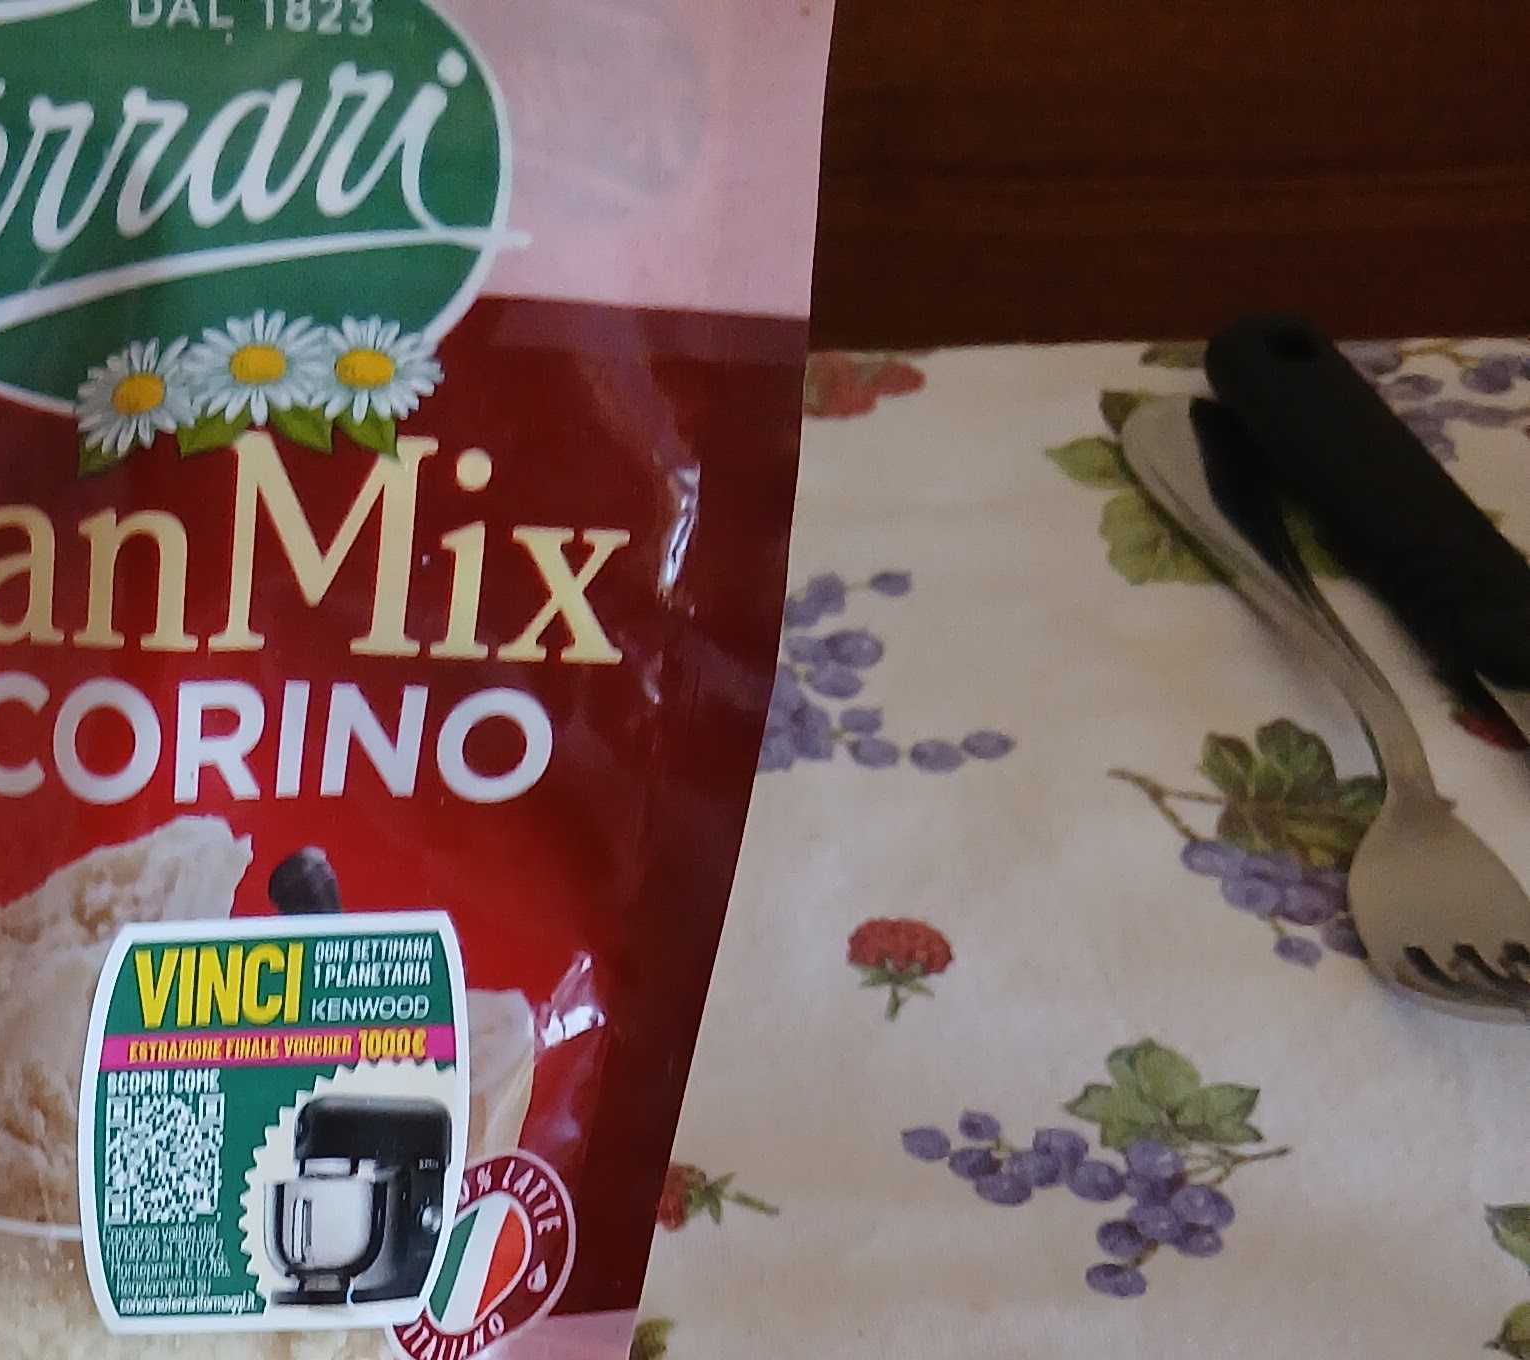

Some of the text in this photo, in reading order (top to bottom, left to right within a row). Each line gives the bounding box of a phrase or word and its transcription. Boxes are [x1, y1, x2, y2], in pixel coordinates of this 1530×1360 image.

[129, 0, 374, 36] DAL 1823
[351, 937, 433, 962] SETTIMANA
[134, 942, 304, 1030] VINCI
[324, 960, 431, 990] PLANETARIA
[311, 994, 430, 1022] KENWOOD
[129, 1039, 223, 1064] ESTRAZIONE
[225, 1036, 280, 1061] FINALE
[283, 1034, 353, 1058] VOUCHER
[107, 1067, 220, 1096] SCOPRI COME
[501, 1159, 563, 1236] LATTE
